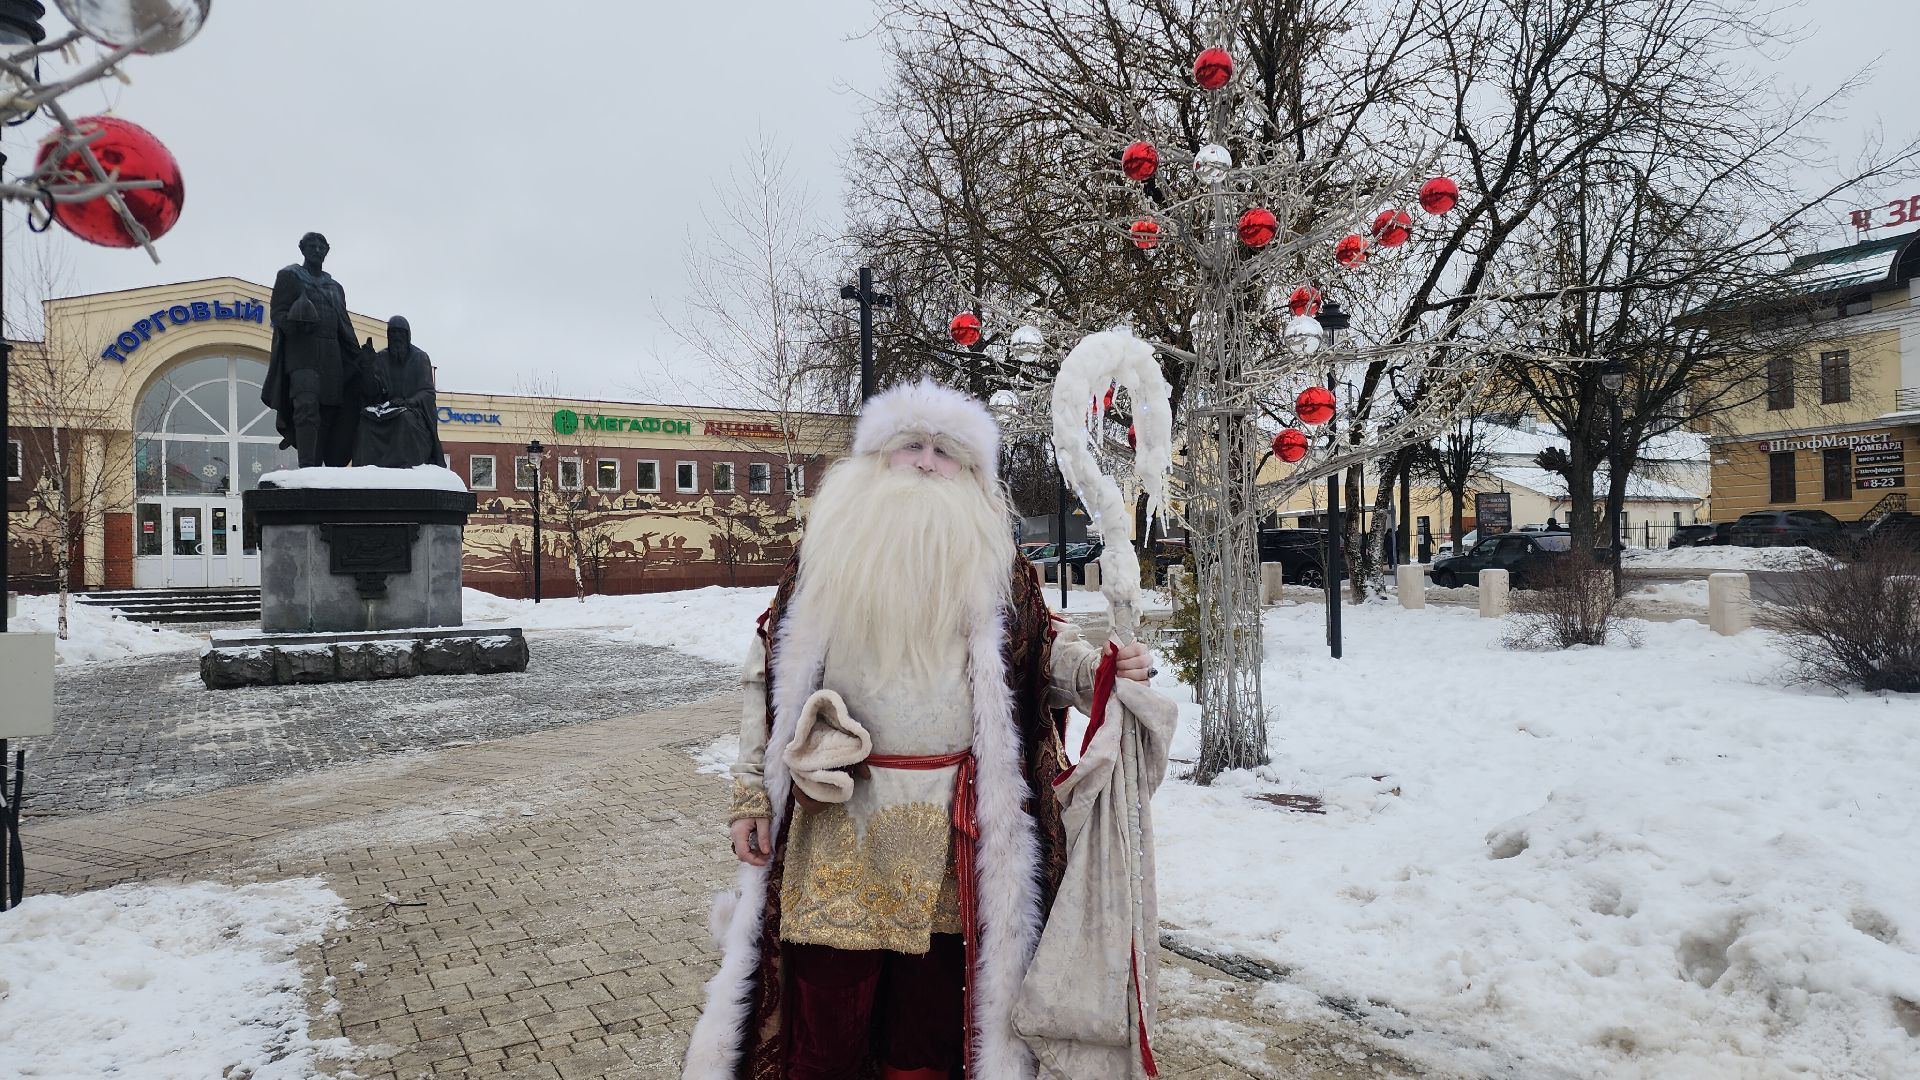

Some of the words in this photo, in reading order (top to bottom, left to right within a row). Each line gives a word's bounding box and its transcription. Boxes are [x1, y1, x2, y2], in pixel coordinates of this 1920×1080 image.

[101, 297, 265, 364] ТОРГОВЫЙ
[1769, 432, 1891, 453] ШтофМаркет
[1854, 441, 1903, 453] ЛОМБАРД
[1870, 478, 1896, 488] 8-23
